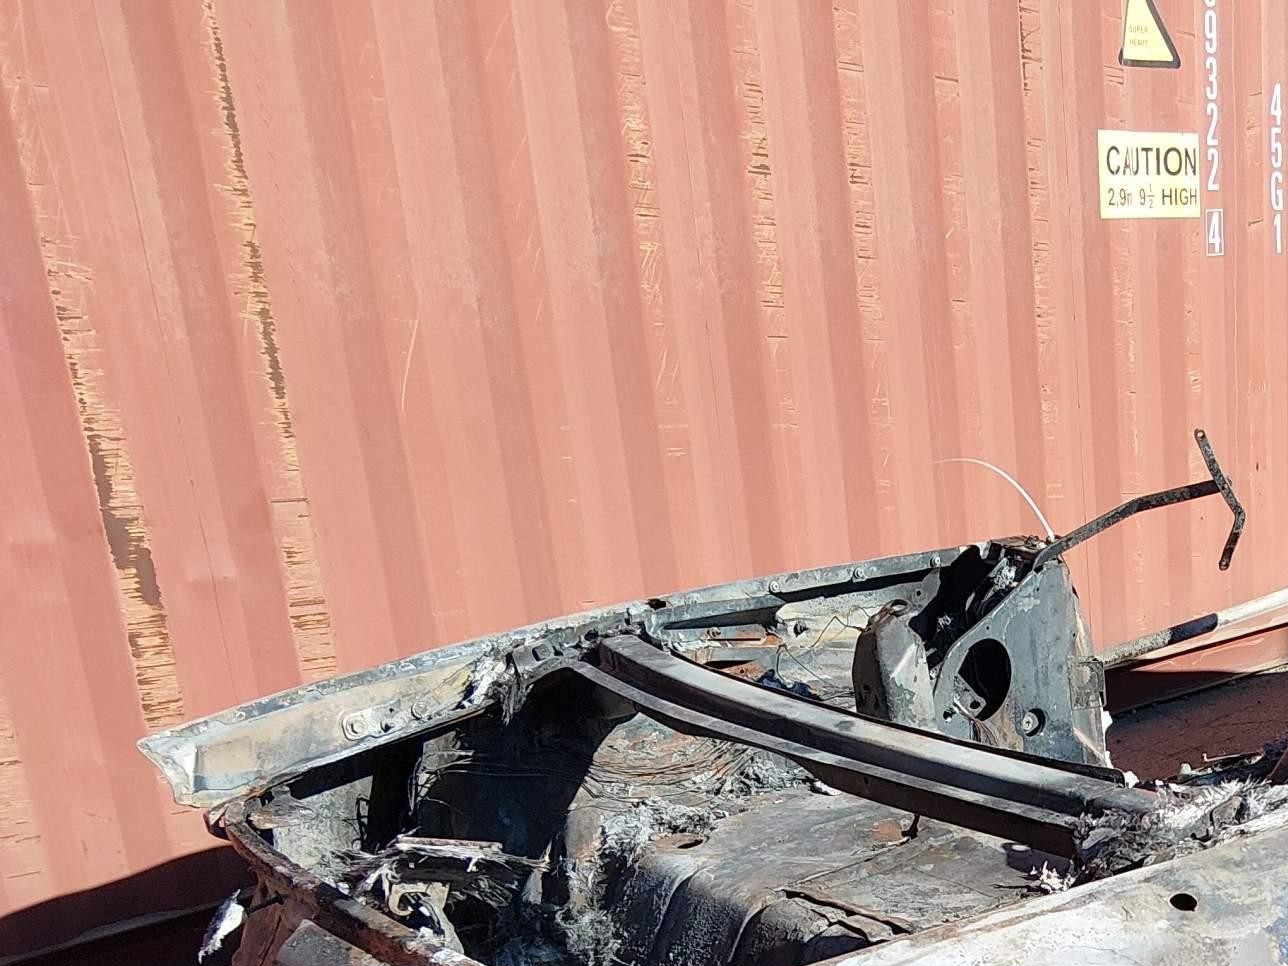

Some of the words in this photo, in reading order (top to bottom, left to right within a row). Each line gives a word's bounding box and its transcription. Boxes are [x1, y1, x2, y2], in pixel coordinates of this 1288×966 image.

[1129, 24, 1149, 34] SUPER
[1129, 39, 1149, 47] HEAVY
[1106, 145, 1197, 176] CAUTION
[1270, 82, 1283, 254] 45G1
[1161, 187, 1198, 206] HIGH
